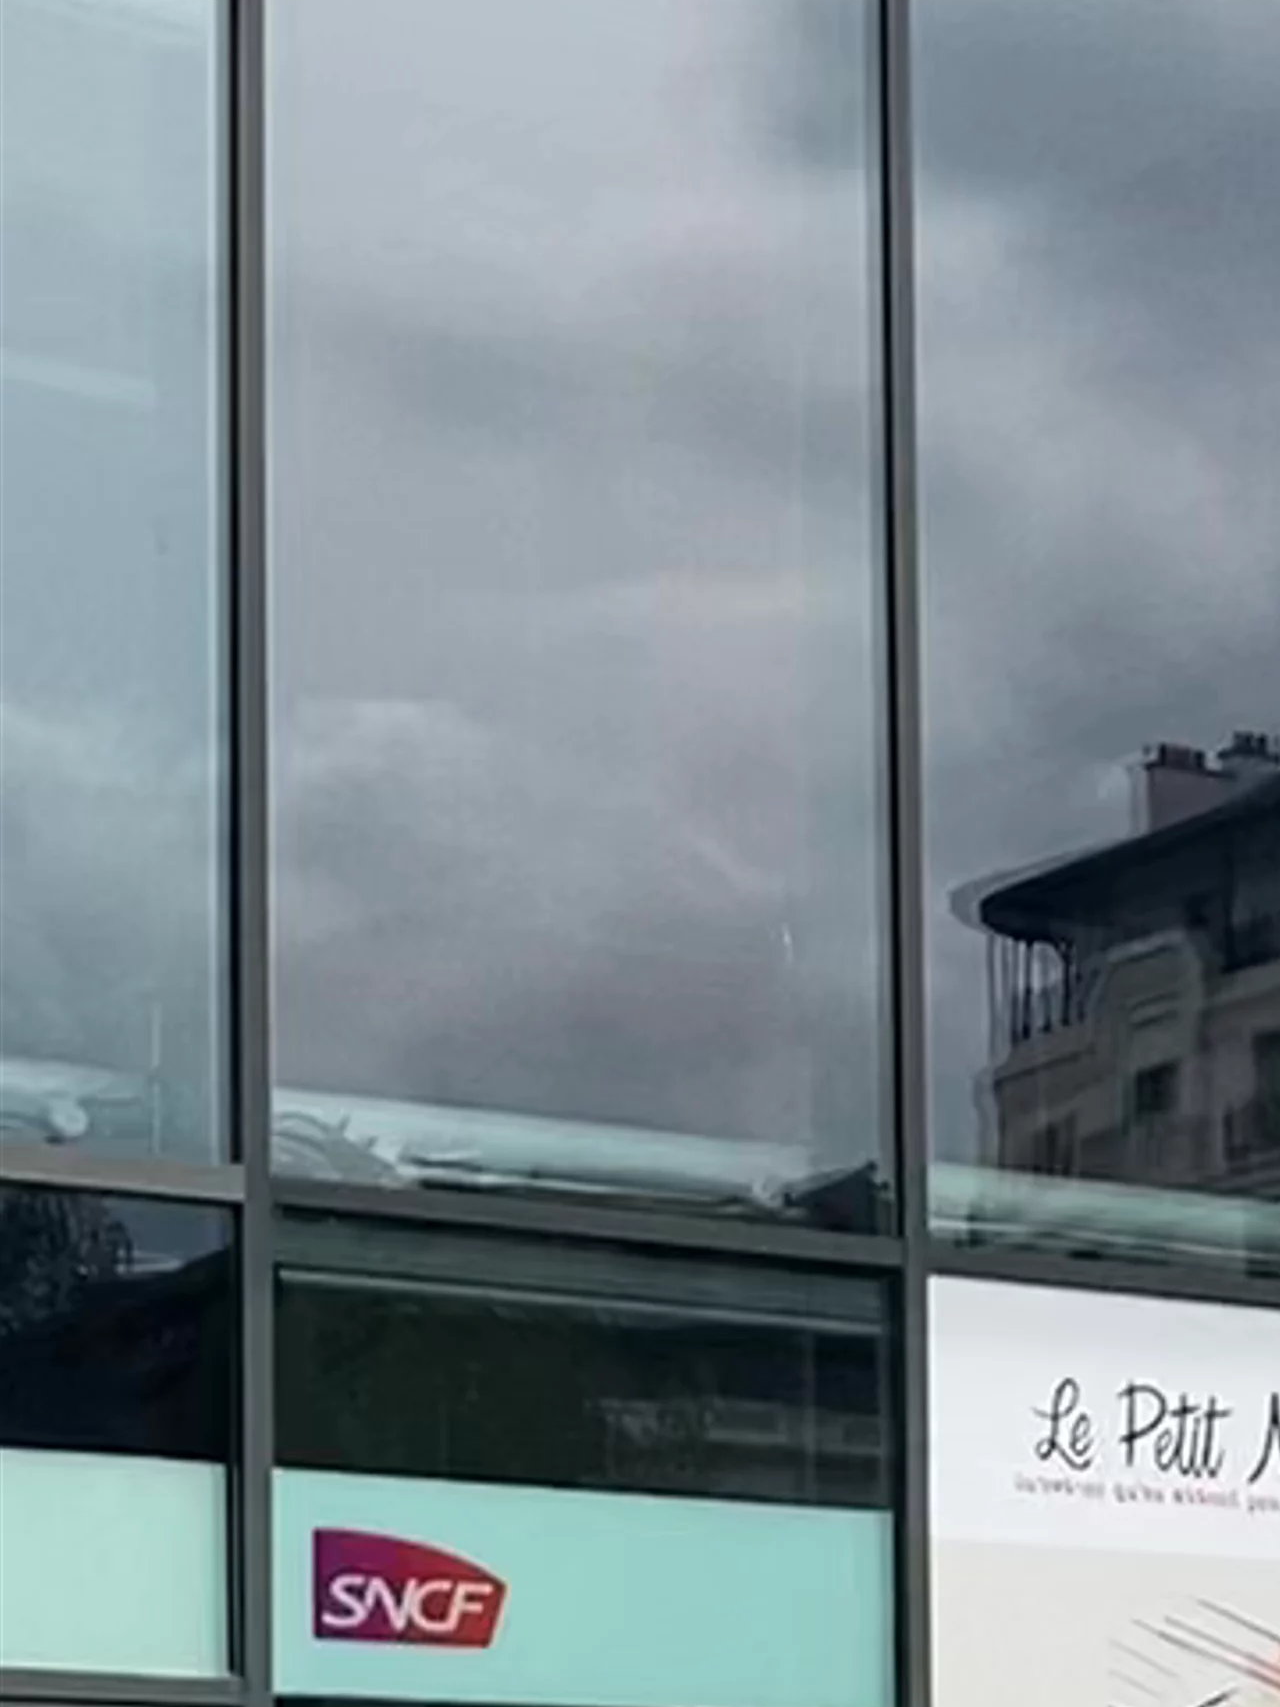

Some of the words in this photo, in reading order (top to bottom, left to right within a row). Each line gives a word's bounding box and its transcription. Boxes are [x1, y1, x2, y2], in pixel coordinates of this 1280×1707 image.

[1031, 1375, 1097, 1473] Le
[1117, 1381, 1233, 1481] Petit
[322, 1573, 495, 1635] SNCF
